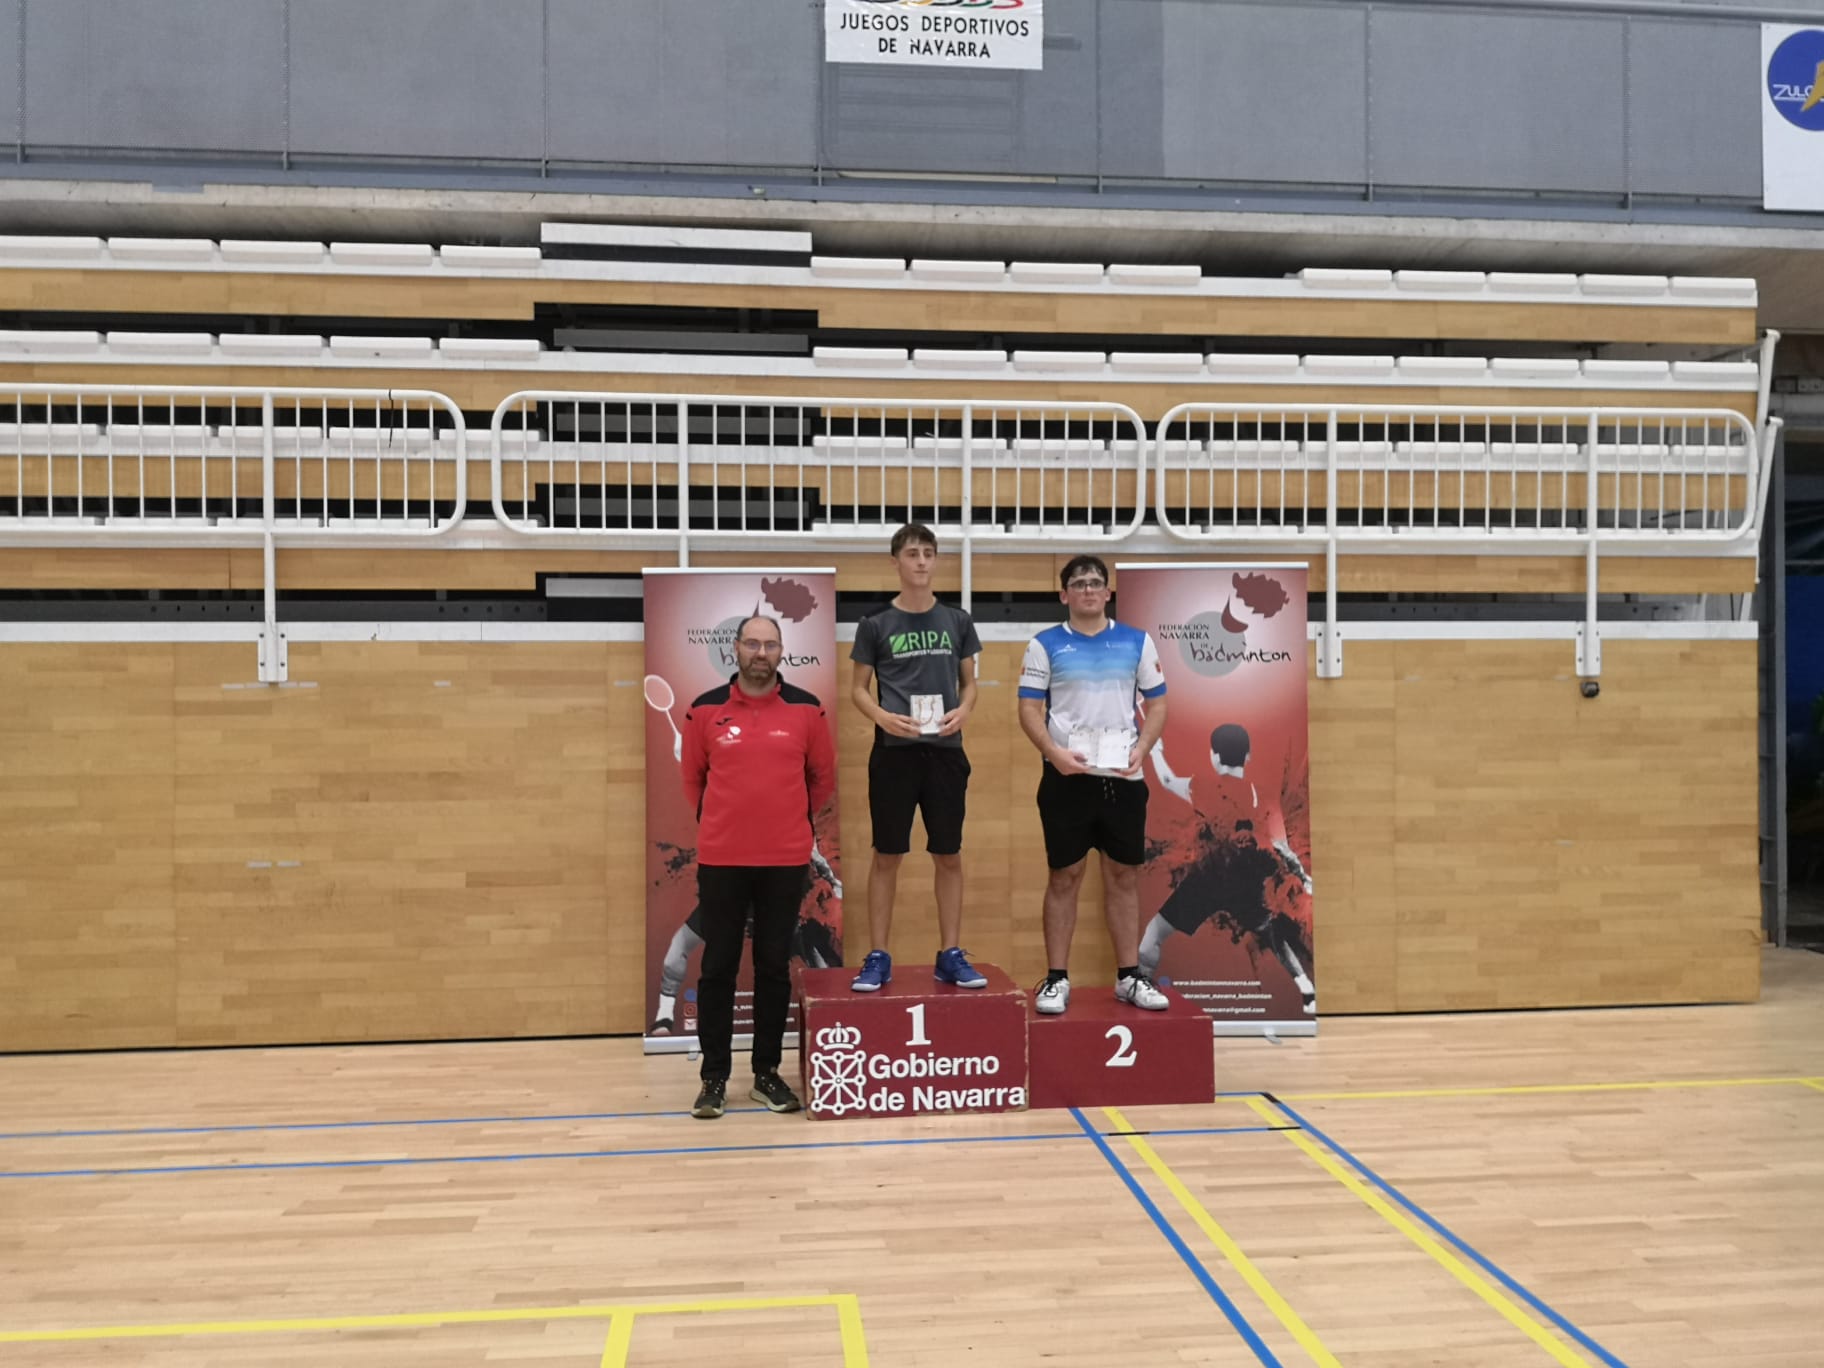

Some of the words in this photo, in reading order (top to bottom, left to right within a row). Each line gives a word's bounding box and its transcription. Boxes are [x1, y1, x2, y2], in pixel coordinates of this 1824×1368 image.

[840, 13, 909, 32] JUEGOS
[921, 16, 1029, 37] DEPORTIVOS
[878, 38, 897, 53] DE
[910, 39, 991, 59] NAVARRA
[908, 630, 952, 650] RIPA
[1159, 632, 1210, 640] NAVARRA
[905, 1003, 931, 1046] 1
[1104, 1024, 1137, 1068] 2
[868, 1052, 1000, 1080] Gobierno
[868, 1086, 905, 1111] de
[912, 1085, 1026, 1112] Navarra
